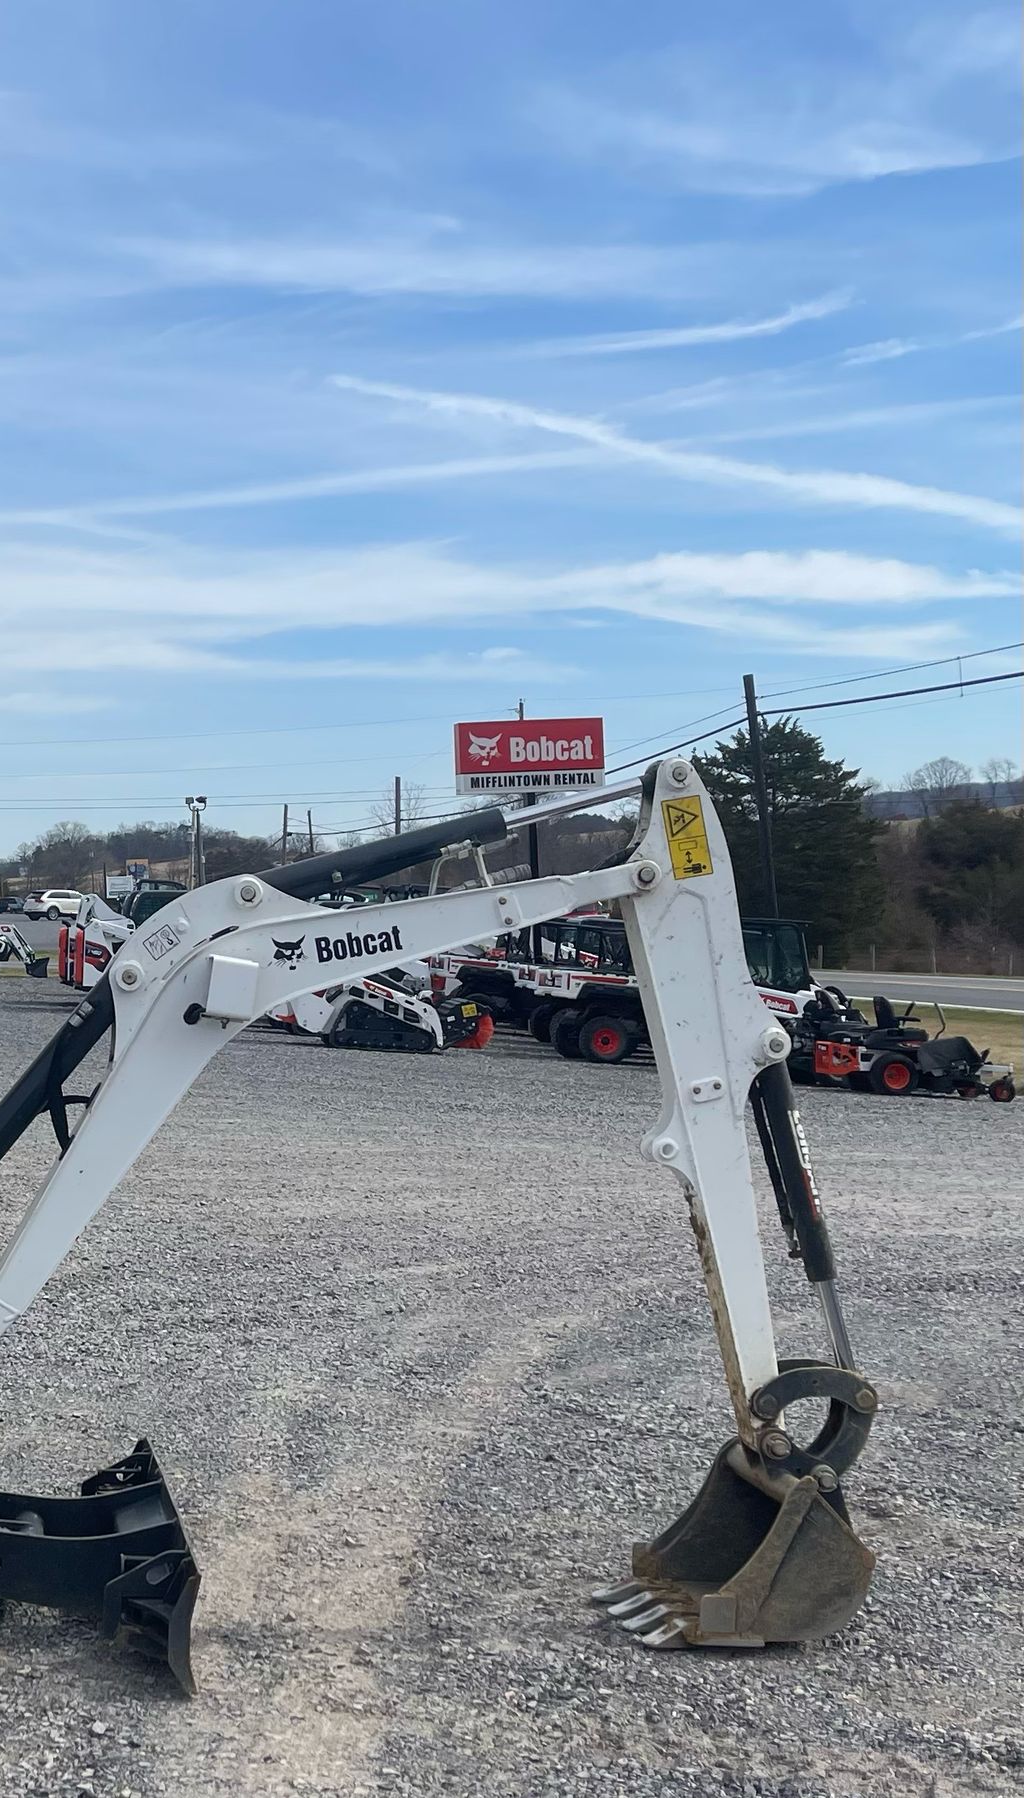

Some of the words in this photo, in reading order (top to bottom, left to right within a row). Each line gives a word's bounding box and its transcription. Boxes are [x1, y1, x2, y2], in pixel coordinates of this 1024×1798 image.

[509, 735, 594, 763] Bobcat
[470, 774, 551, 789] MIFFLINTOWN
[554, 772, 597, 786] RENTAL
[314, 925, 403, 963] Bobcat
